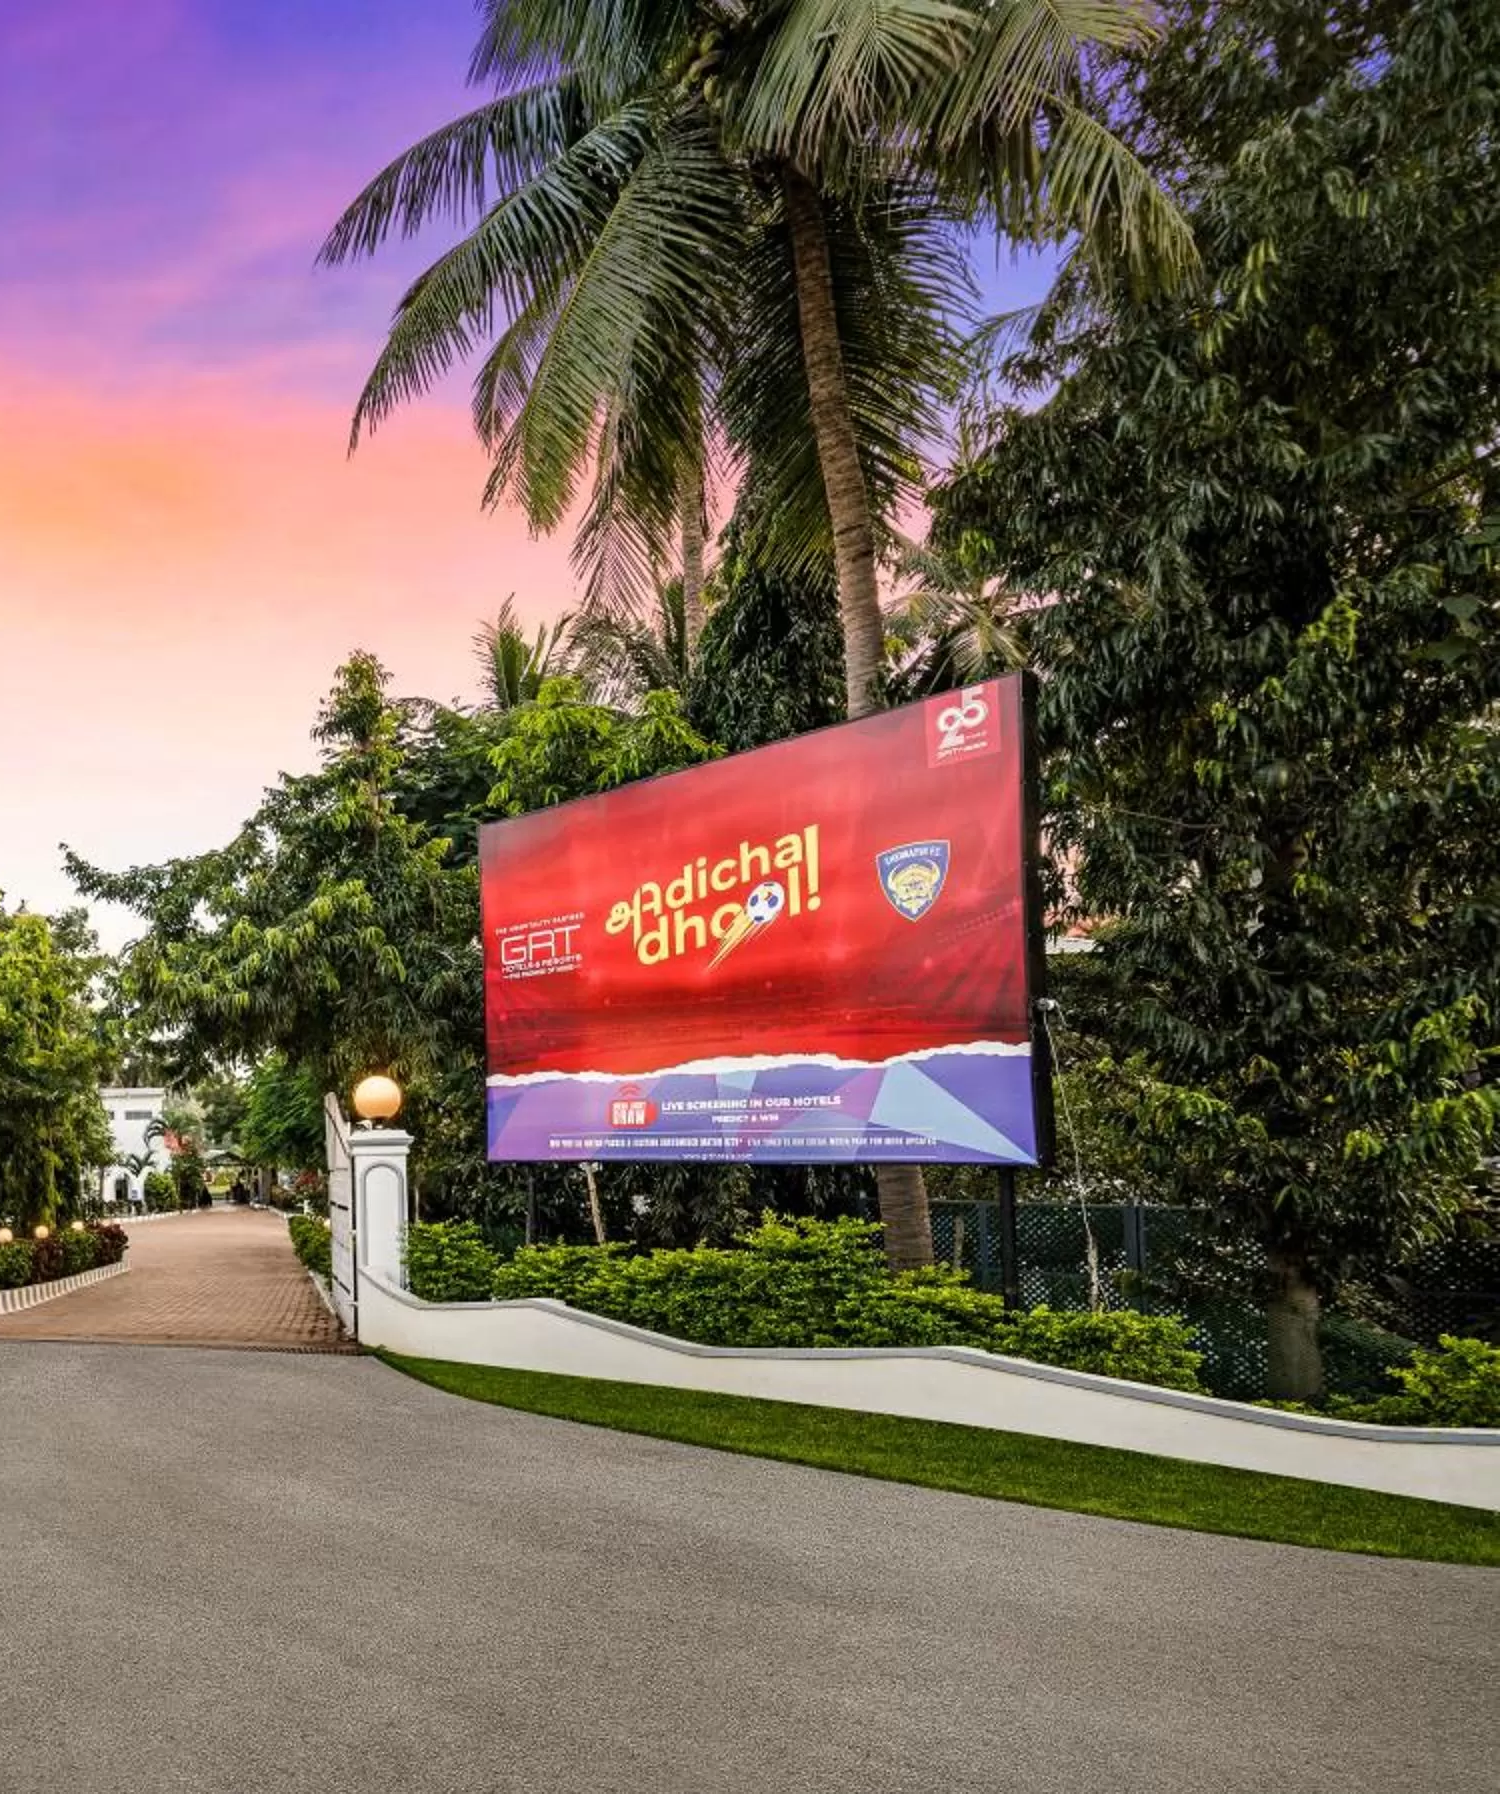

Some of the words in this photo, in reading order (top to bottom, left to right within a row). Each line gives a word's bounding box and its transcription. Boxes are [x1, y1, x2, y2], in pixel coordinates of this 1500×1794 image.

[501, 924, 581, 965] GRT
[661, 1101, 684, 1111] LIVE
[686, 1100, 747, 1111] SCREENING
[750, 1099, 763, 1109] IN
[765, 1097, 791, 1108] OUR
[793, 1095, 842, 1107] HOTELS
